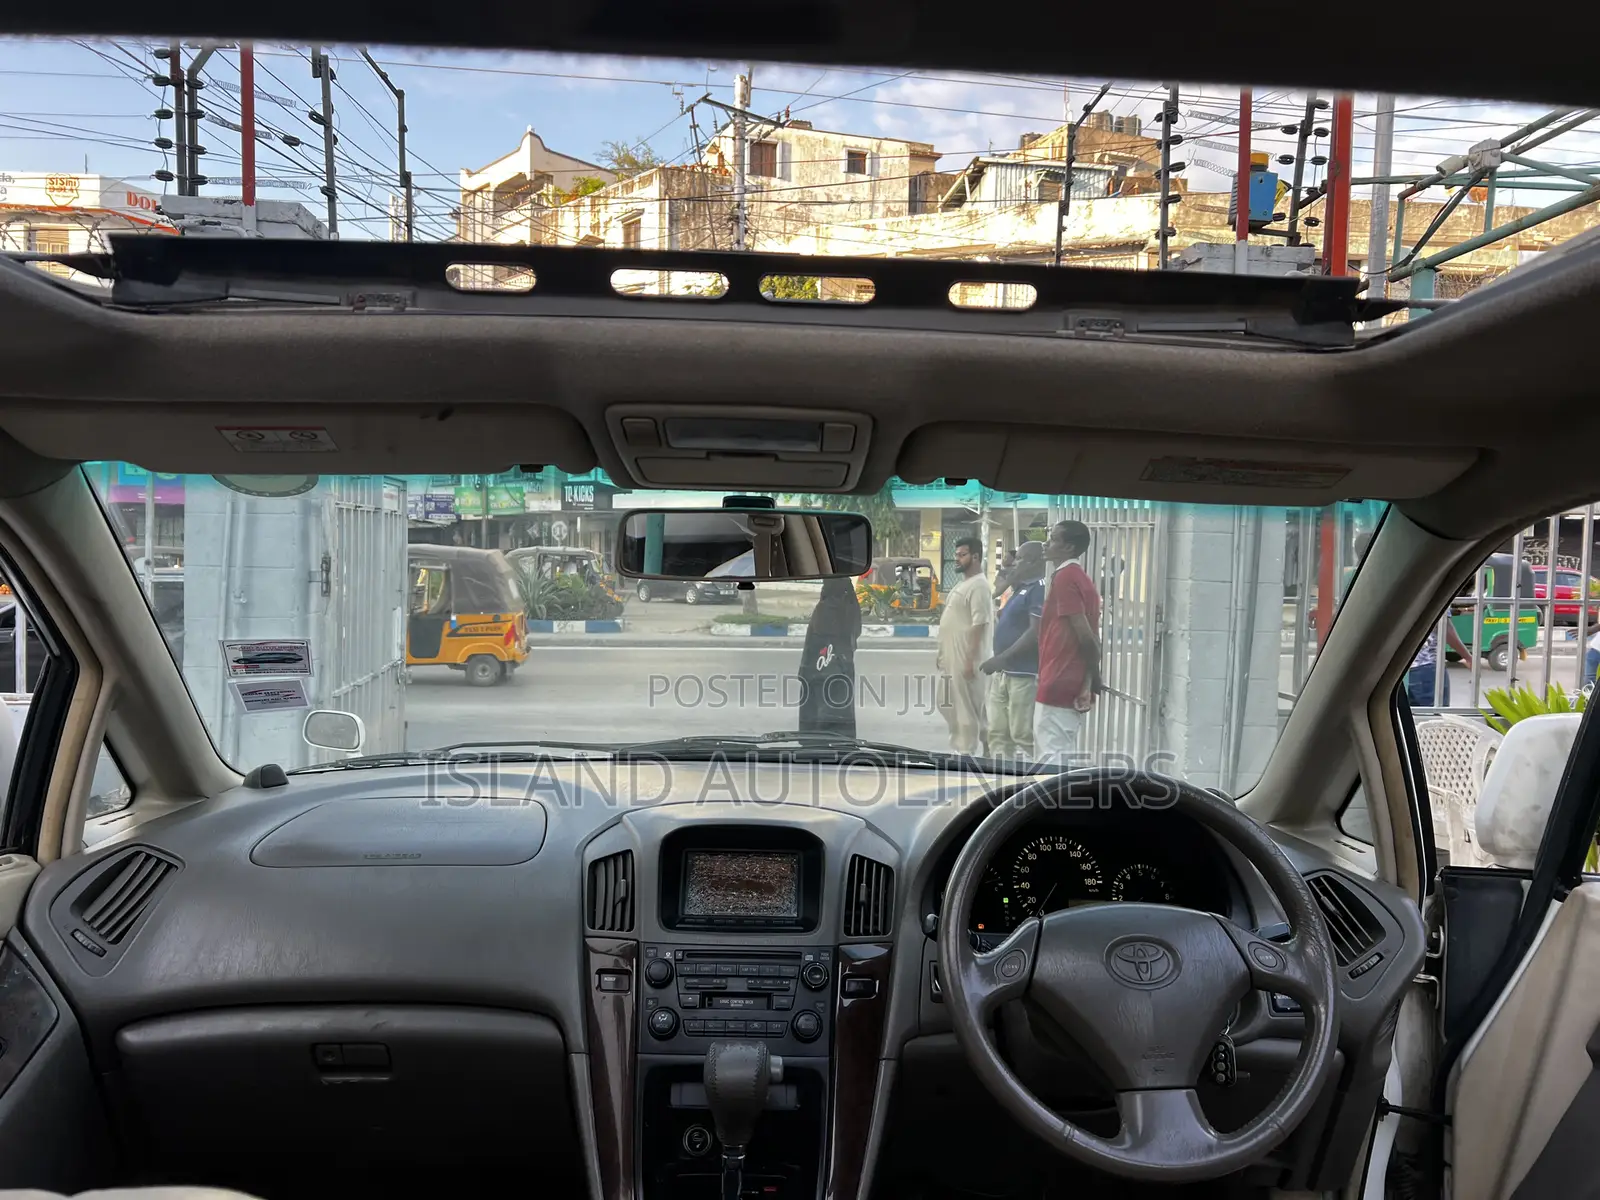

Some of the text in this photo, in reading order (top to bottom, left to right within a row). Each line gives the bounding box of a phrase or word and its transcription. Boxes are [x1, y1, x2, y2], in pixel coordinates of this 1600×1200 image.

[1039, 844, 1052, 852] 100
[1055, 842, 1067, 850] 120
[1027, 853, 1037, 861] 80
[1069, 850, 1082, 858] 140
[1020, 866, 1030, 874] 60
[1079, 863, 1092, 871] 160
[1020, 881, 1030, 890] 40
[1084, 878, 1097, 886] 180
[1027, 896, 1037, 904] 20
